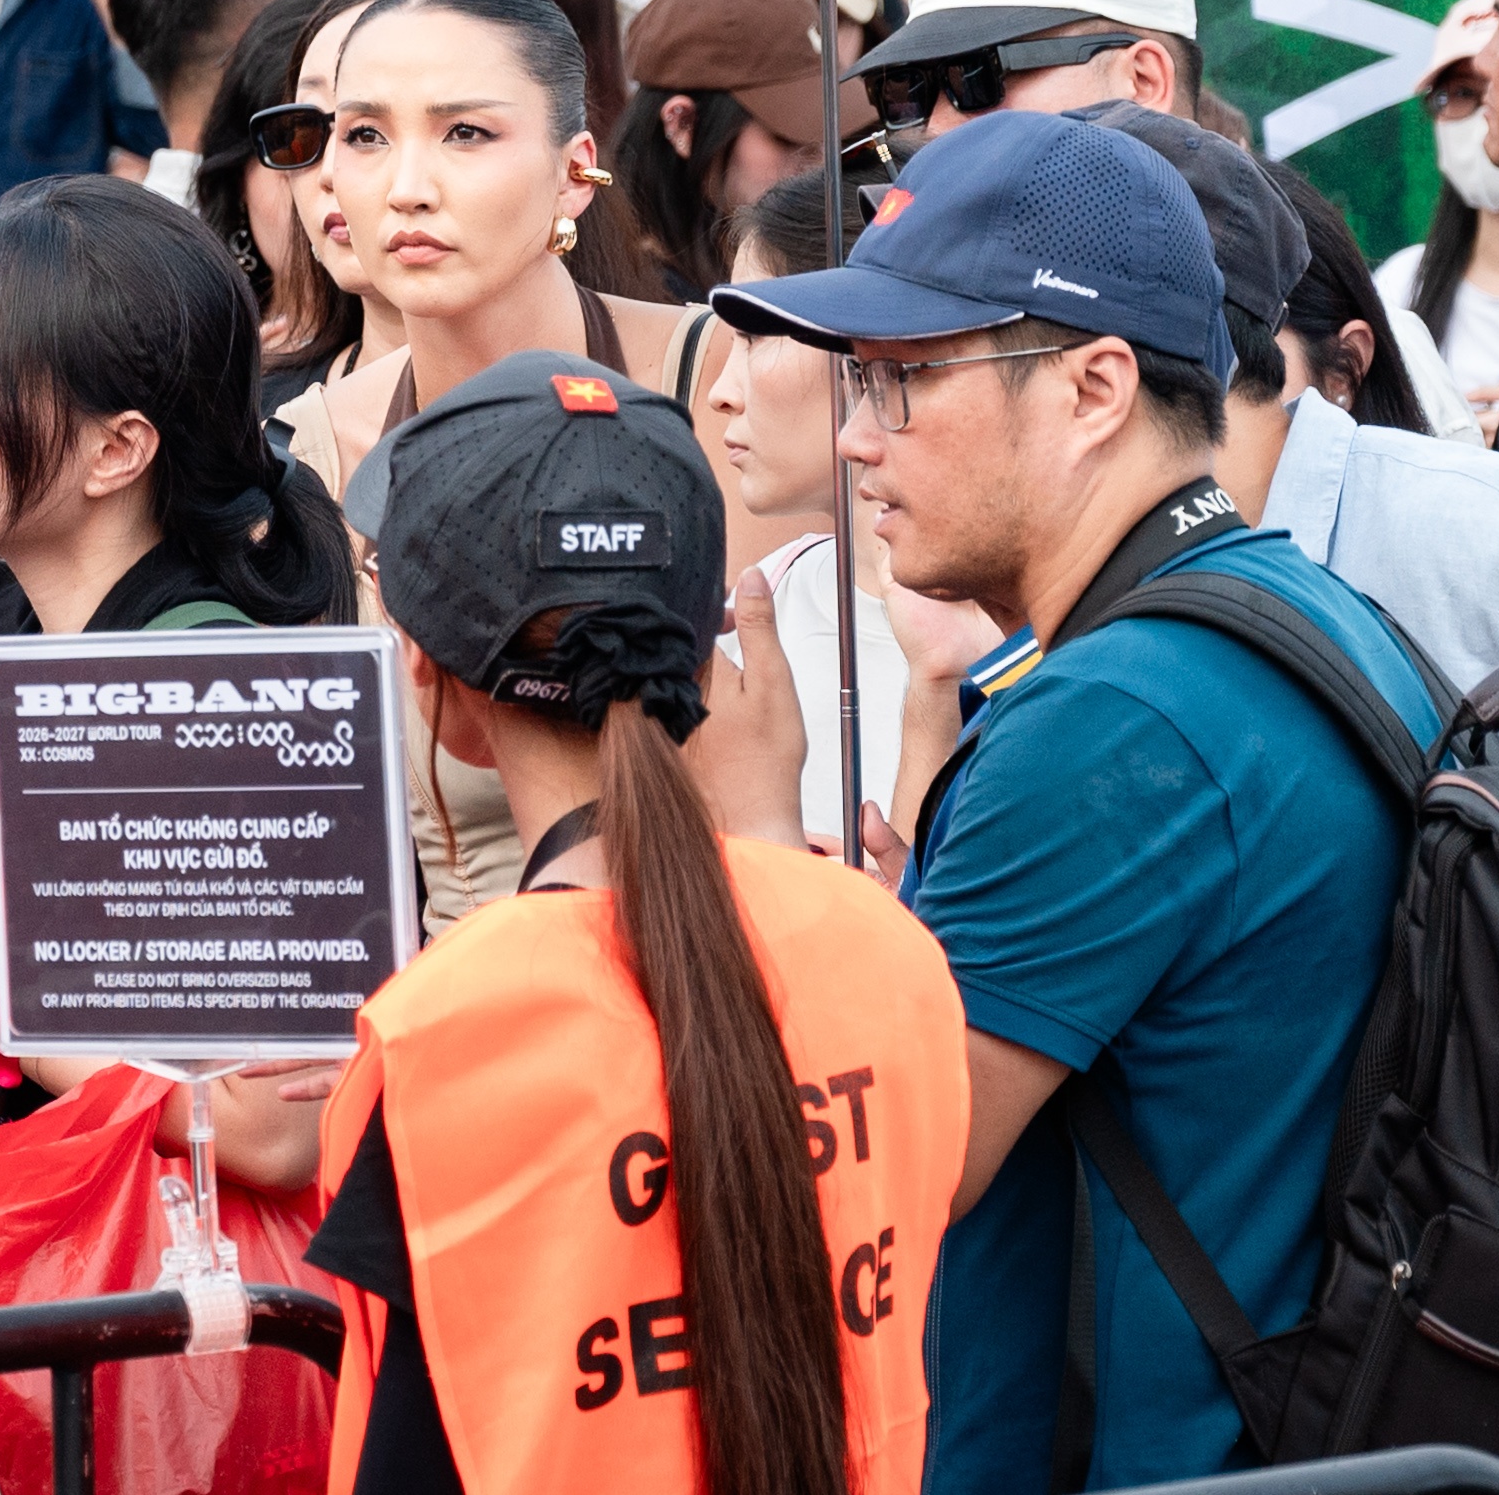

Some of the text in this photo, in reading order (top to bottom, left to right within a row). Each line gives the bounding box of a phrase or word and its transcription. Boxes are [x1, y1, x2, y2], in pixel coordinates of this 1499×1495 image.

[1169, 487, 1239, 537] ONY
[560, 522, 646, 553] STAFF
[14, 677, 361, 717] BIGBANG
[18, 724, 162, 743] 2026-2027 WORLD TOUR
[59, 811, 331, 841] BAN TỔ CHỨC KHÔNG CUNG CẤP
[123, 848, 161, 870] KHU
[163, 846, 202, 875] VỰC
[204, 842, 234, 870] GỬI
[32, 882, 52, 897] VUI
[54, 879, 85, 897] LÒNG
[87, 878, 127, 896] KHÔNG
[128, 881, 163, 896] MANG
[164, 878, 182, 896] TÚI
[254, 877, 279, 896] CÁC
[303, 881, 336, 899] DỤNG
[104, 902, 134, 917] THEO
[135, 902, 160, 917] QUY
[162, 902, 188, 920] ĐỊNH
[190, 898, 215, 917] CỦA
[216, 901, 242, 917] BAN
[34, 939, 370, 962] NO LOCKER / STORAGE AREA PROVIDED.
[94, 971, 312, 988] PLEASE DO NOT BRING OVERSIZED BAGS
[41, 993, 60, 1009] OR
[60, 993, 84, 1008] ANY
[86, 993, 150, 1008] PROHIBITED
[151, 993, 185, 1008] ITEMS
[186, 993, 204, 1008] AS
[204, 993, 260, 1009] SPECIFIED
[261, 993, 276, 1008] BY
[277, 993, 301, 1008] THE
[607, 1065, 876, 1228] GST
[574, 1226, 897, 1413] SECE
